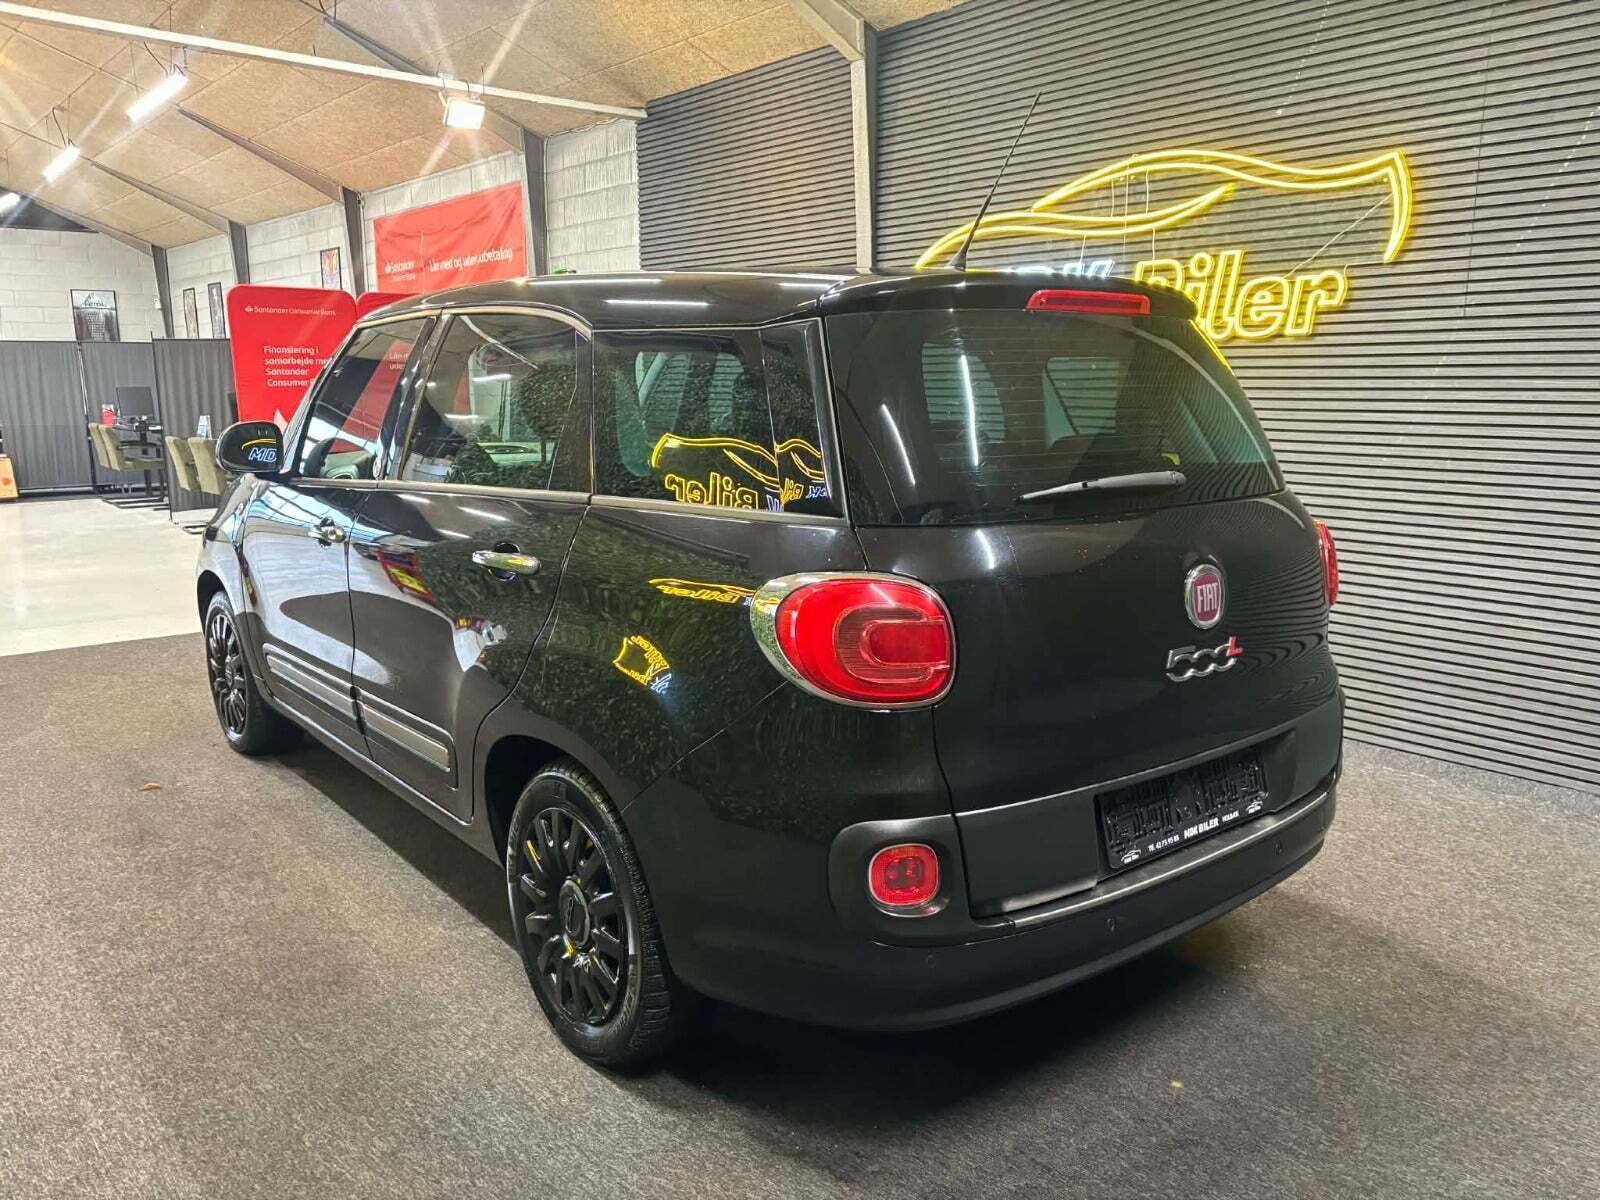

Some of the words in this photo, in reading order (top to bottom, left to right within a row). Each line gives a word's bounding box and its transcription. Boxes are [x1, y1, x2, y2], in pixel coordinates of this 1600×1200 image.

[253, 306, 288, 314] Santander
[263, 345, 315, 355] Finansiering
[265, 357, 314, 366] samarbejde
[266, 367, 308, 376] Santander
[267, 378, 309, 387] Consumer
[1197, 582, 1219, 613] FIAT
[1199, 817, 1219, 833] BILER
